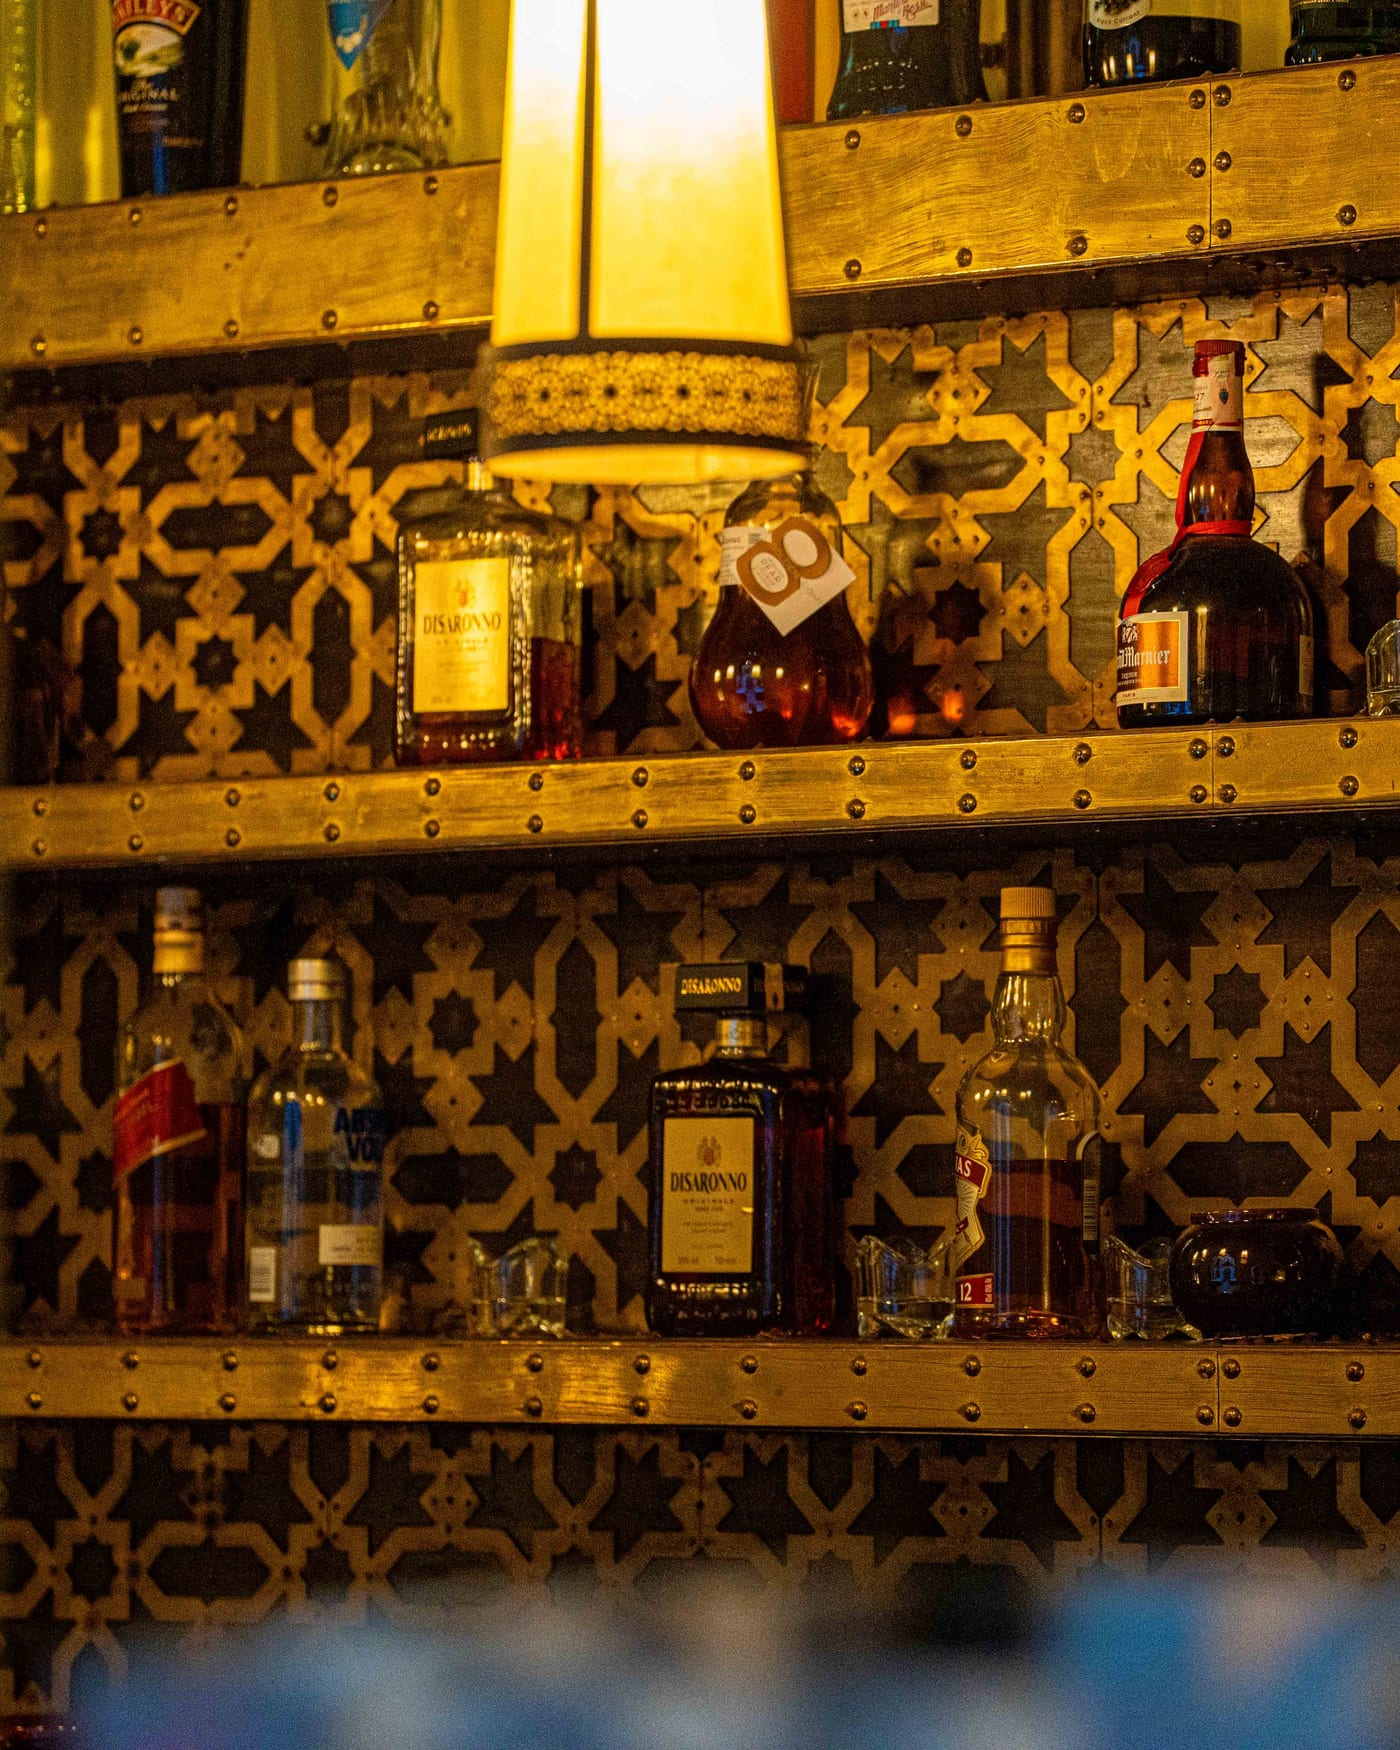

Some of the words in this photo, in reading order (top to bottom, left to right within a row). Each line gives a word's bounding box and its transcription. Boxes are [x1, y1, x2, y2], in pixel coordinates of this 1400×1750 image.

[113, 0, 186, 23] AILEYS
[423, 612, 502, 635] DISARONNO
[681, 977, 742, 994] DISARONNO
[670, 1172, 747, 1194] DISARONNO
[959, 1282, 973, 1302] 12
